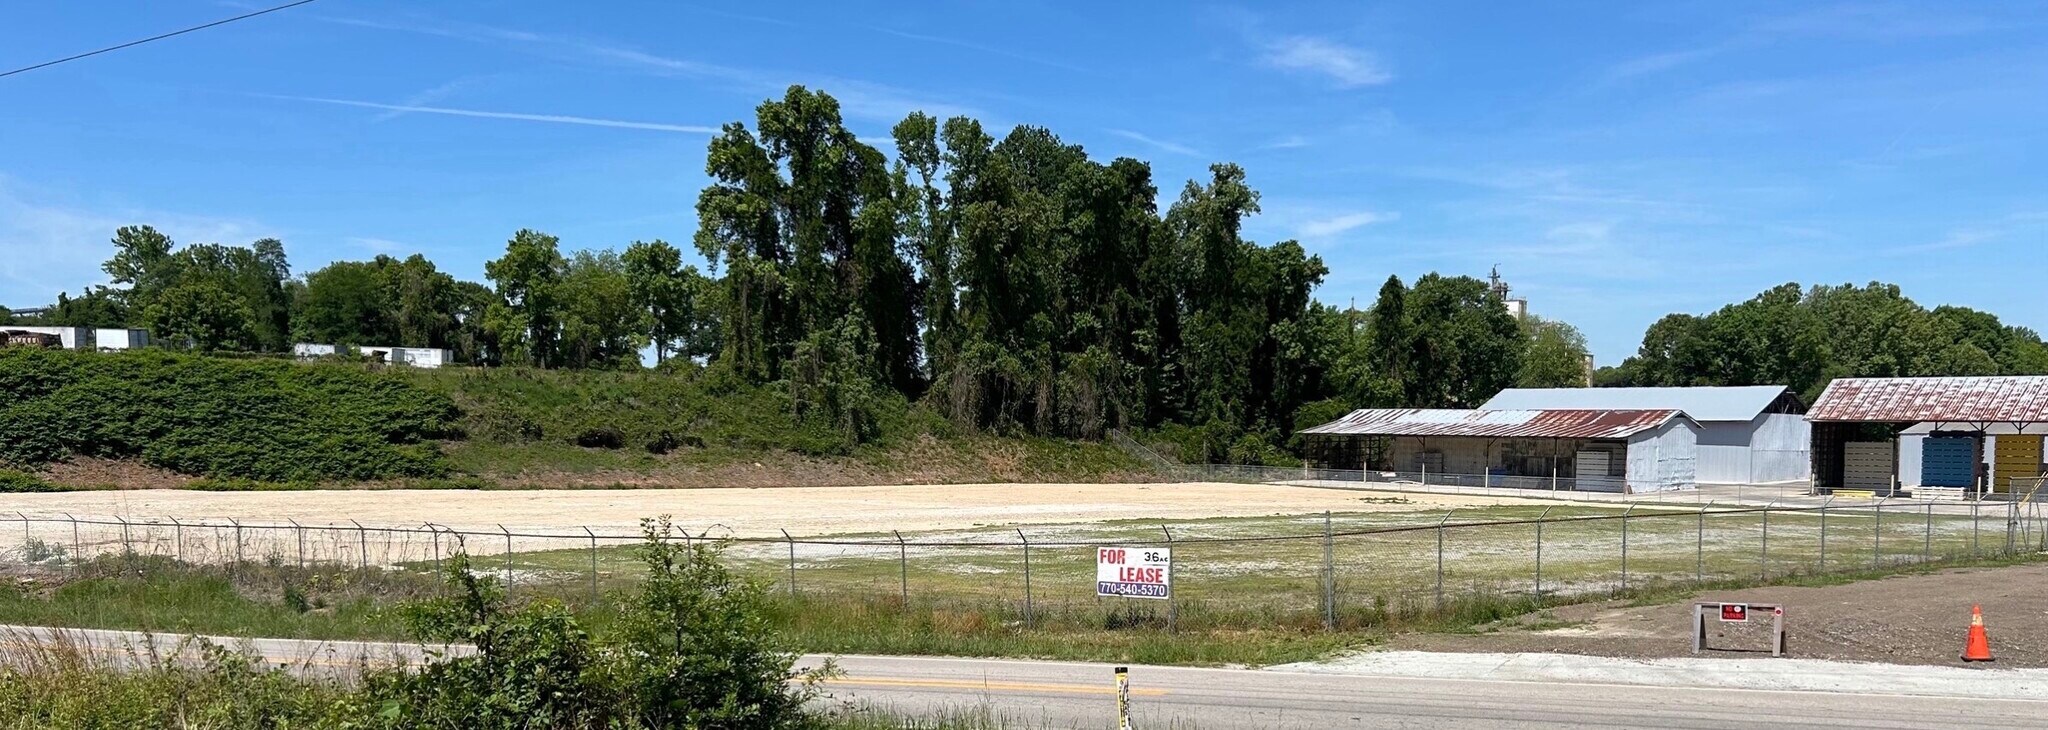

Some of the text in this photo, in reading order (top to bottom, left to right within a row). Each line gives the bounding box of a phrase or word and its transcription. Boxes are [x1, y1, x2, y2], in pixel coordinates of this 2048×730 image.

[1100, 549, 1125, 564] FOR
[1119, 567, 1163, 583] LEASE
[1100, 583, 1165, 595] 770-540-5370
